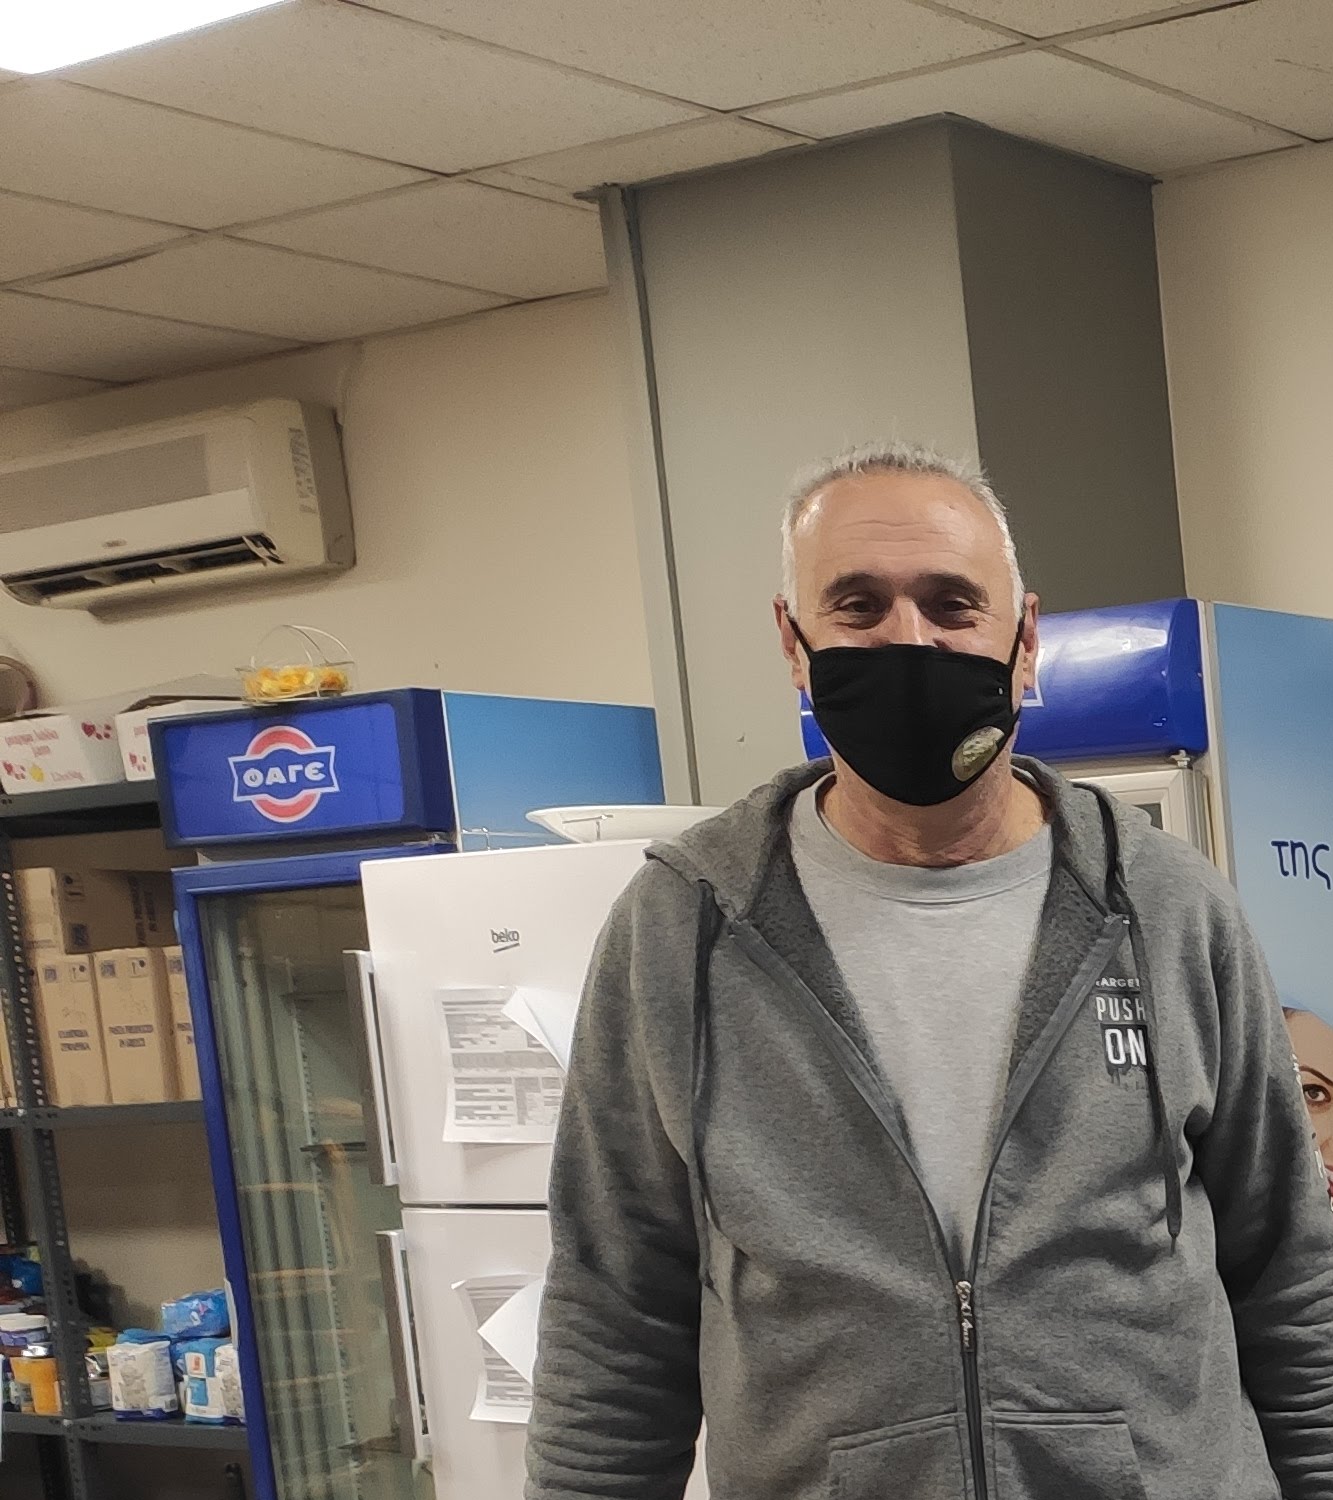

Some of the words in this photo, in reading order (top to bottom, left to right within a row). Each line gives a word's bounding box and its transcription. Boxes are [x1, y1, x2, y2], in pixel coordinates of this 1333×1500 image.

[1271, 840, 1331, 891] της
[490, 928, 520, 943] beko
[1096, 996, 1147, 1021] PUSH
[1104, 1028, 1147, 1066] ON
